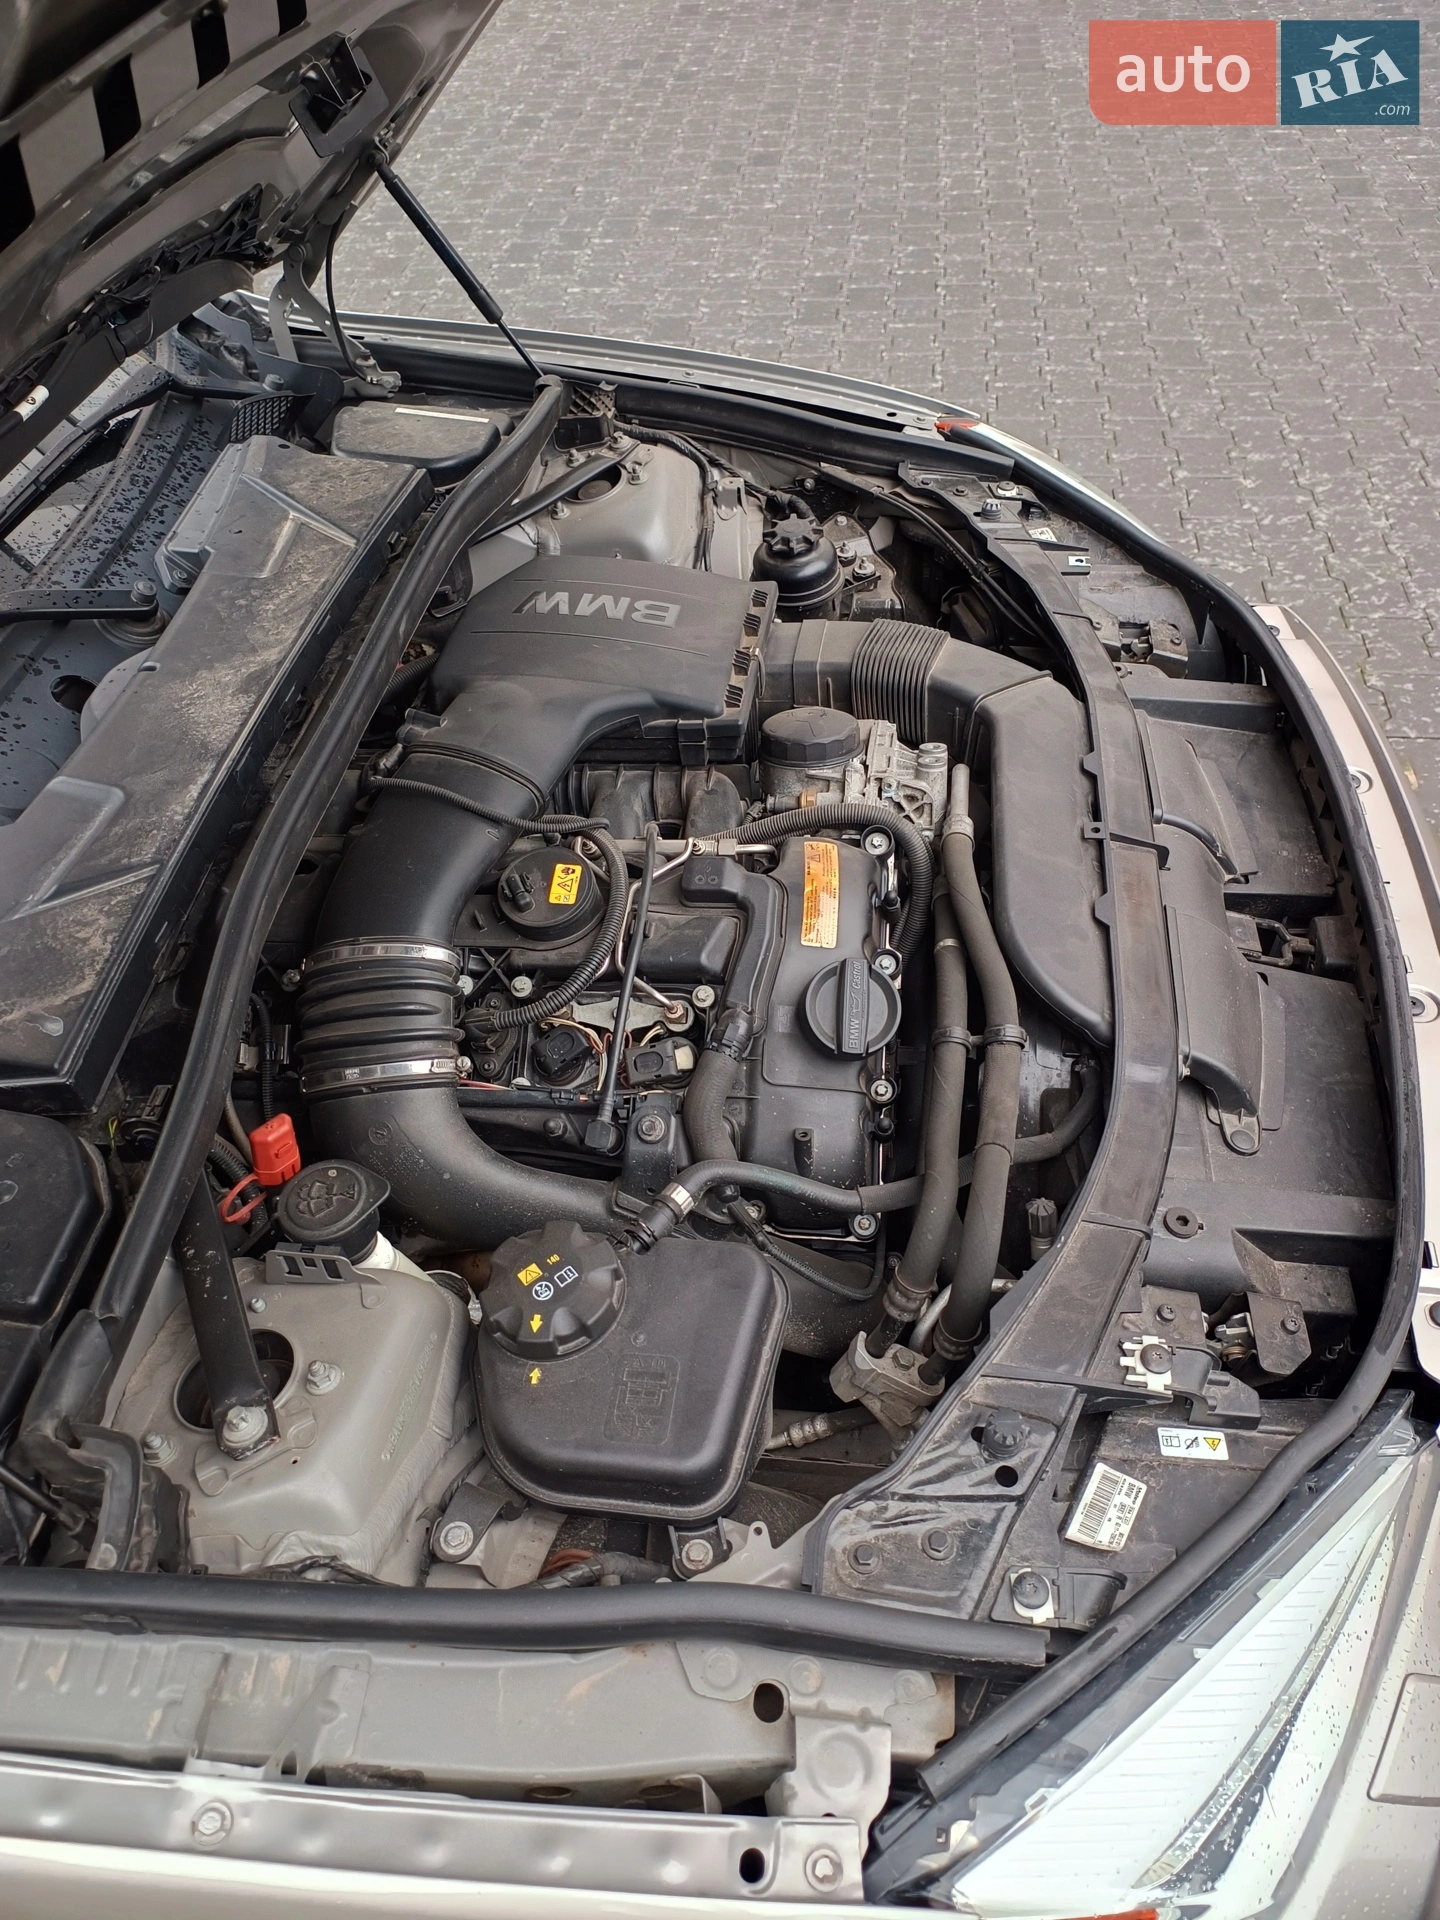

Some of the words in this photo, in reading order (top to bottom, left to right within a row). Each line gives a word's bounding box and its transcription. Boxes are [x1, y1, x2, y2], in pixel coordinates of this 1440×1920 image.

[511, 591, 682, 628] BMW
[851, 960, 862, 990] Castrol
[848, 1018, 862, 1050] BMW
[546, 1253, 561, 1266] 140
